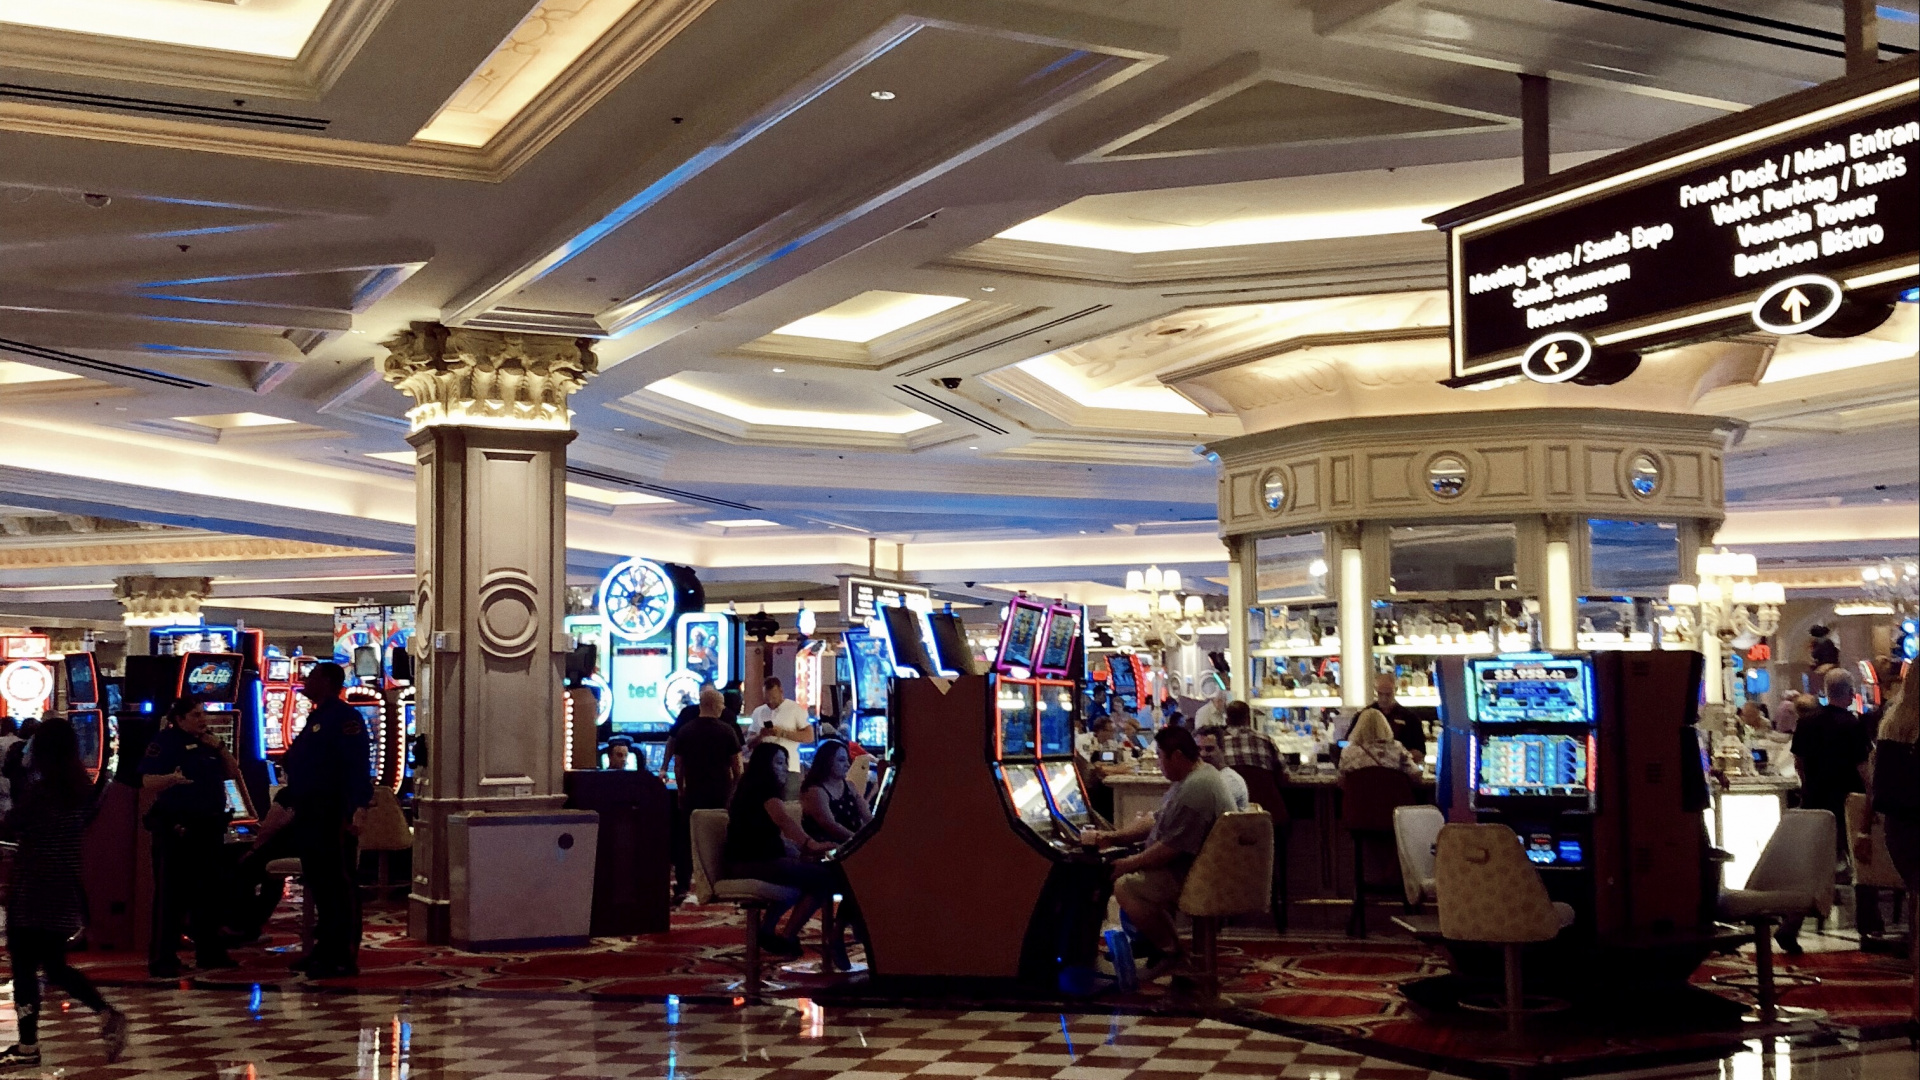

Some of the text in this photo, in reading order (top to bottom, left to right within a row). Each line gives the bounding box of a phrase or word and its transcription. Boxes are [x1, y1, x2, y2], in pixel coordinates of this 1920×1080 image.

[1680, 176, 1729, 208] Front
[1731, 159, 1779, 193] Desk
[1794, 141, 1846, 175] Main
[1711, 195, 1760, 226] Valet
[1763, 175, 1838, 213] Parking
[1852, 153, 1907, 187] Taxis
[1737, 195, 1878, 247] Venezia Tower
[1469, 265, 1526, 295] Meeting
[1527, 252, 1572, 281] Space
[1582, 231, 1630, 263] Sands
[1632, 223, 1674, 250] Expo
[1734, 224, 1884, 278] Bouchon Bistro
[1512, 263, 1630, 308] Sands Showroom
[1527, 293, 1608, 329] Restrooms
[628, 682, 657, 698] ted
